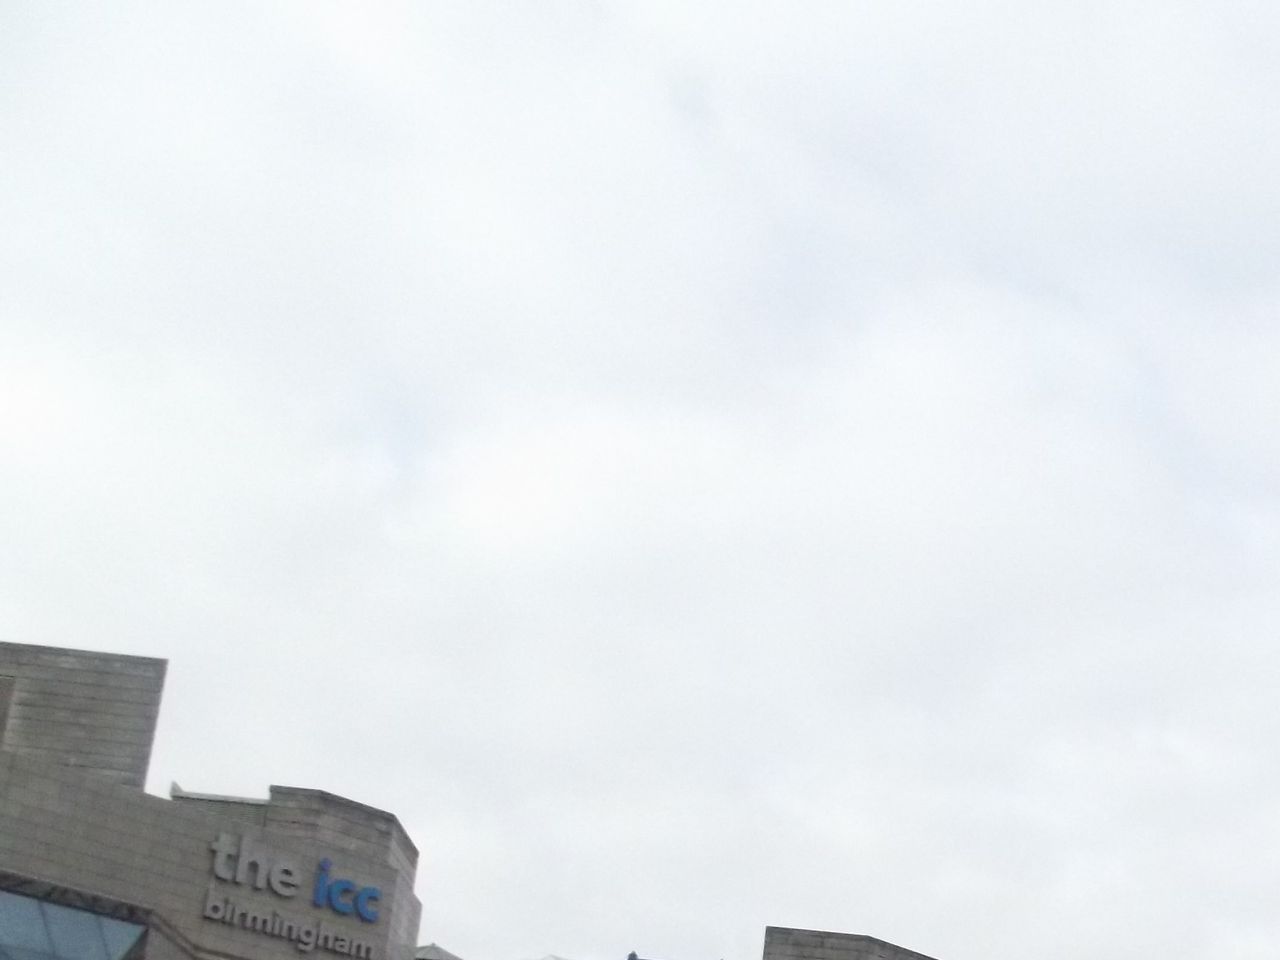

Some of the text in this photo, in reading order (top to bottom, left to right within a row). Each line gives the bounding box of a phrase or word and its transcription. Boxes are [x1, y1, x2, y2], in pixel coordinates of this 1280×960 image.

[209, 830, 382, 924] the icc
[203, 887, 374, 960] birmingham
